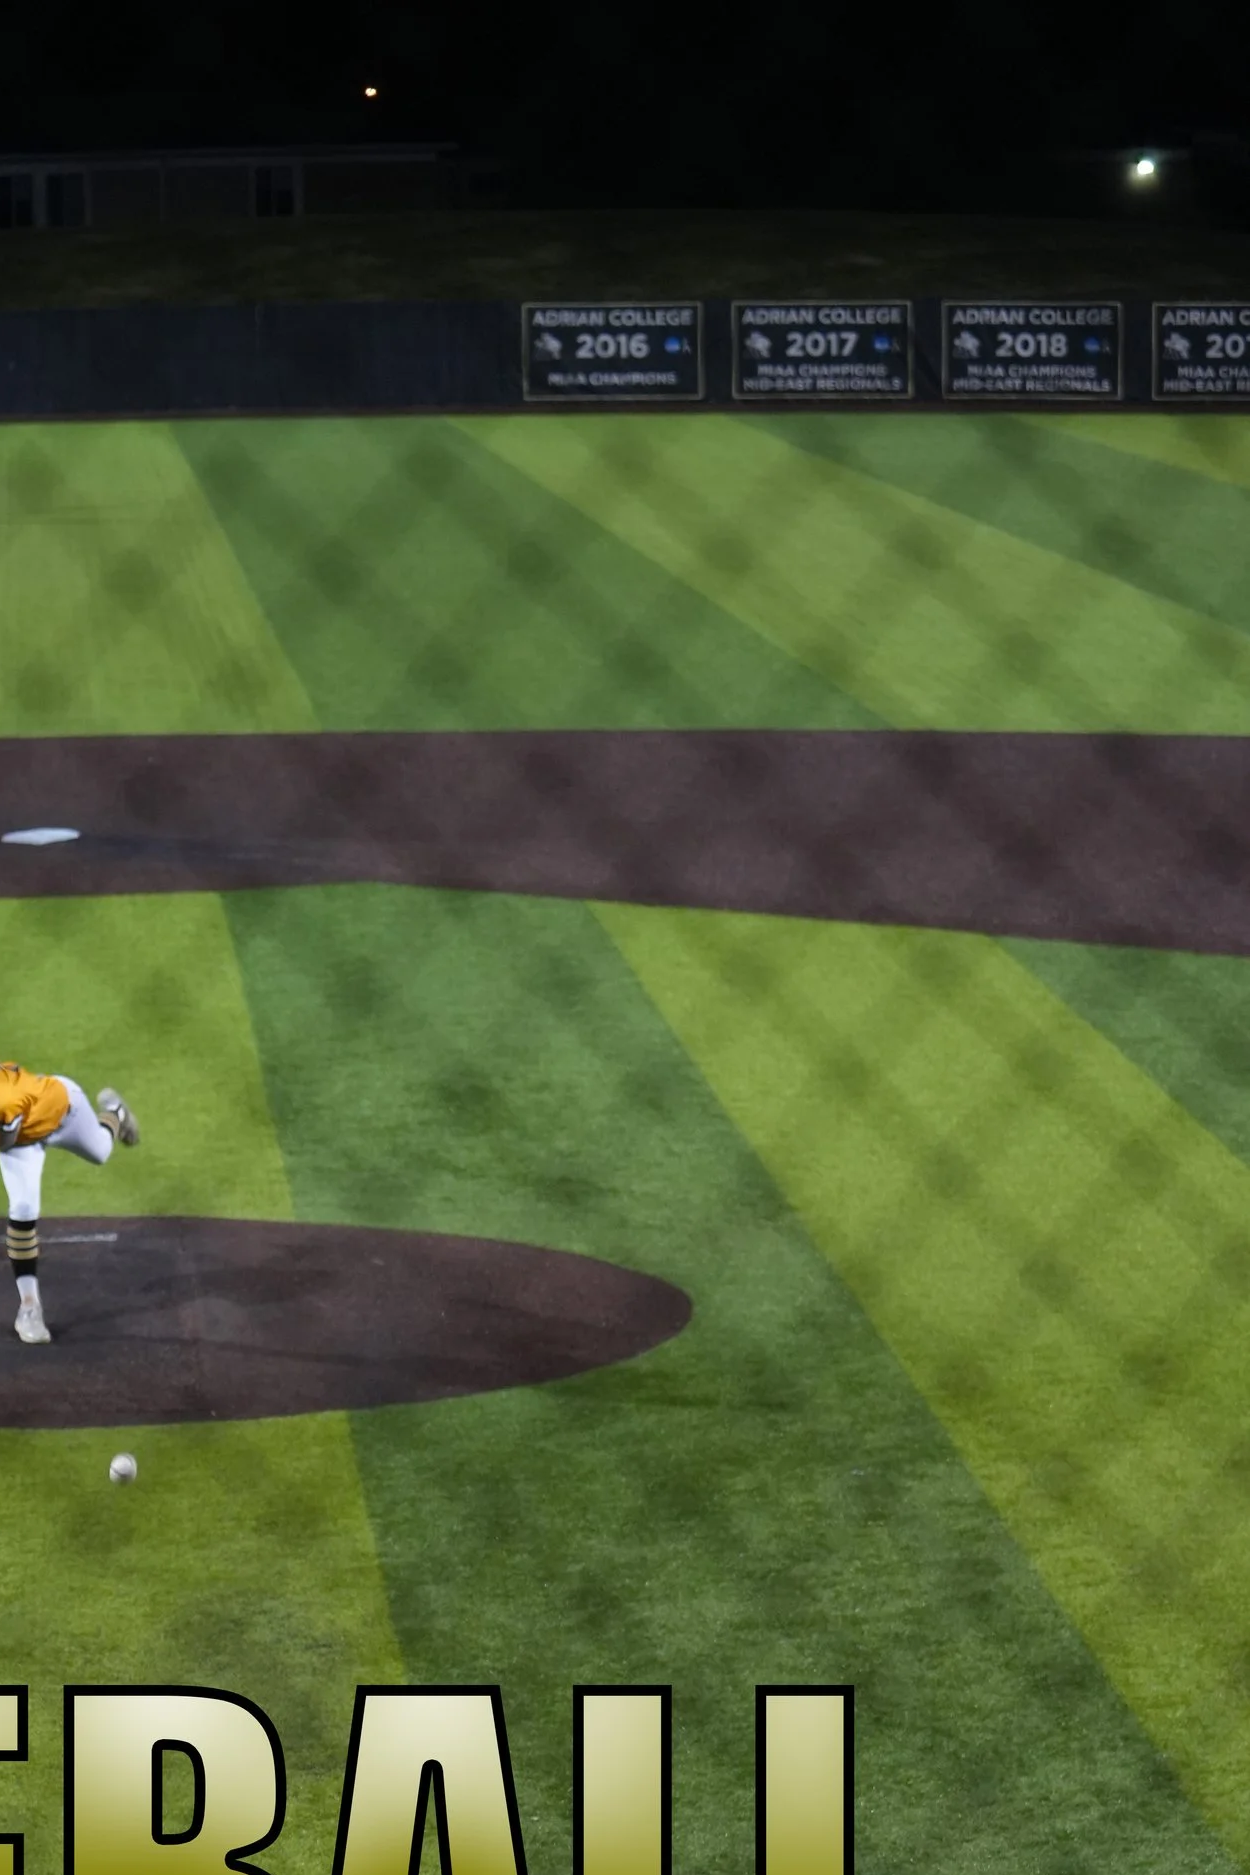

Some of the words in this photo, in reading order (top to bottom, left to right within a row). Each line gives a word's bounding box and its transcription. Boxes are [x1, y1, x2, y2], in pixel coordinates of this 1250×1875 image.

[532, 309, 605, 327] ADRIAN
[608, 308, 693, 326] COLLEGE
[742, 307, 814, 325] ADRIAN
[818, 307, 901, 325] COLLEGE
[952, 308, 1024, 325] ADRIAN
[1028, 308, 1114, 325] COLLEGE
[1162, 309, 1235, 325] ADRIAN
[575, 332, 649, 359] 2016
[785, 330, 859, 357] 2017
[995, 331, 1068, 358] 2018
[1206, 333, 1250, 358] 20
